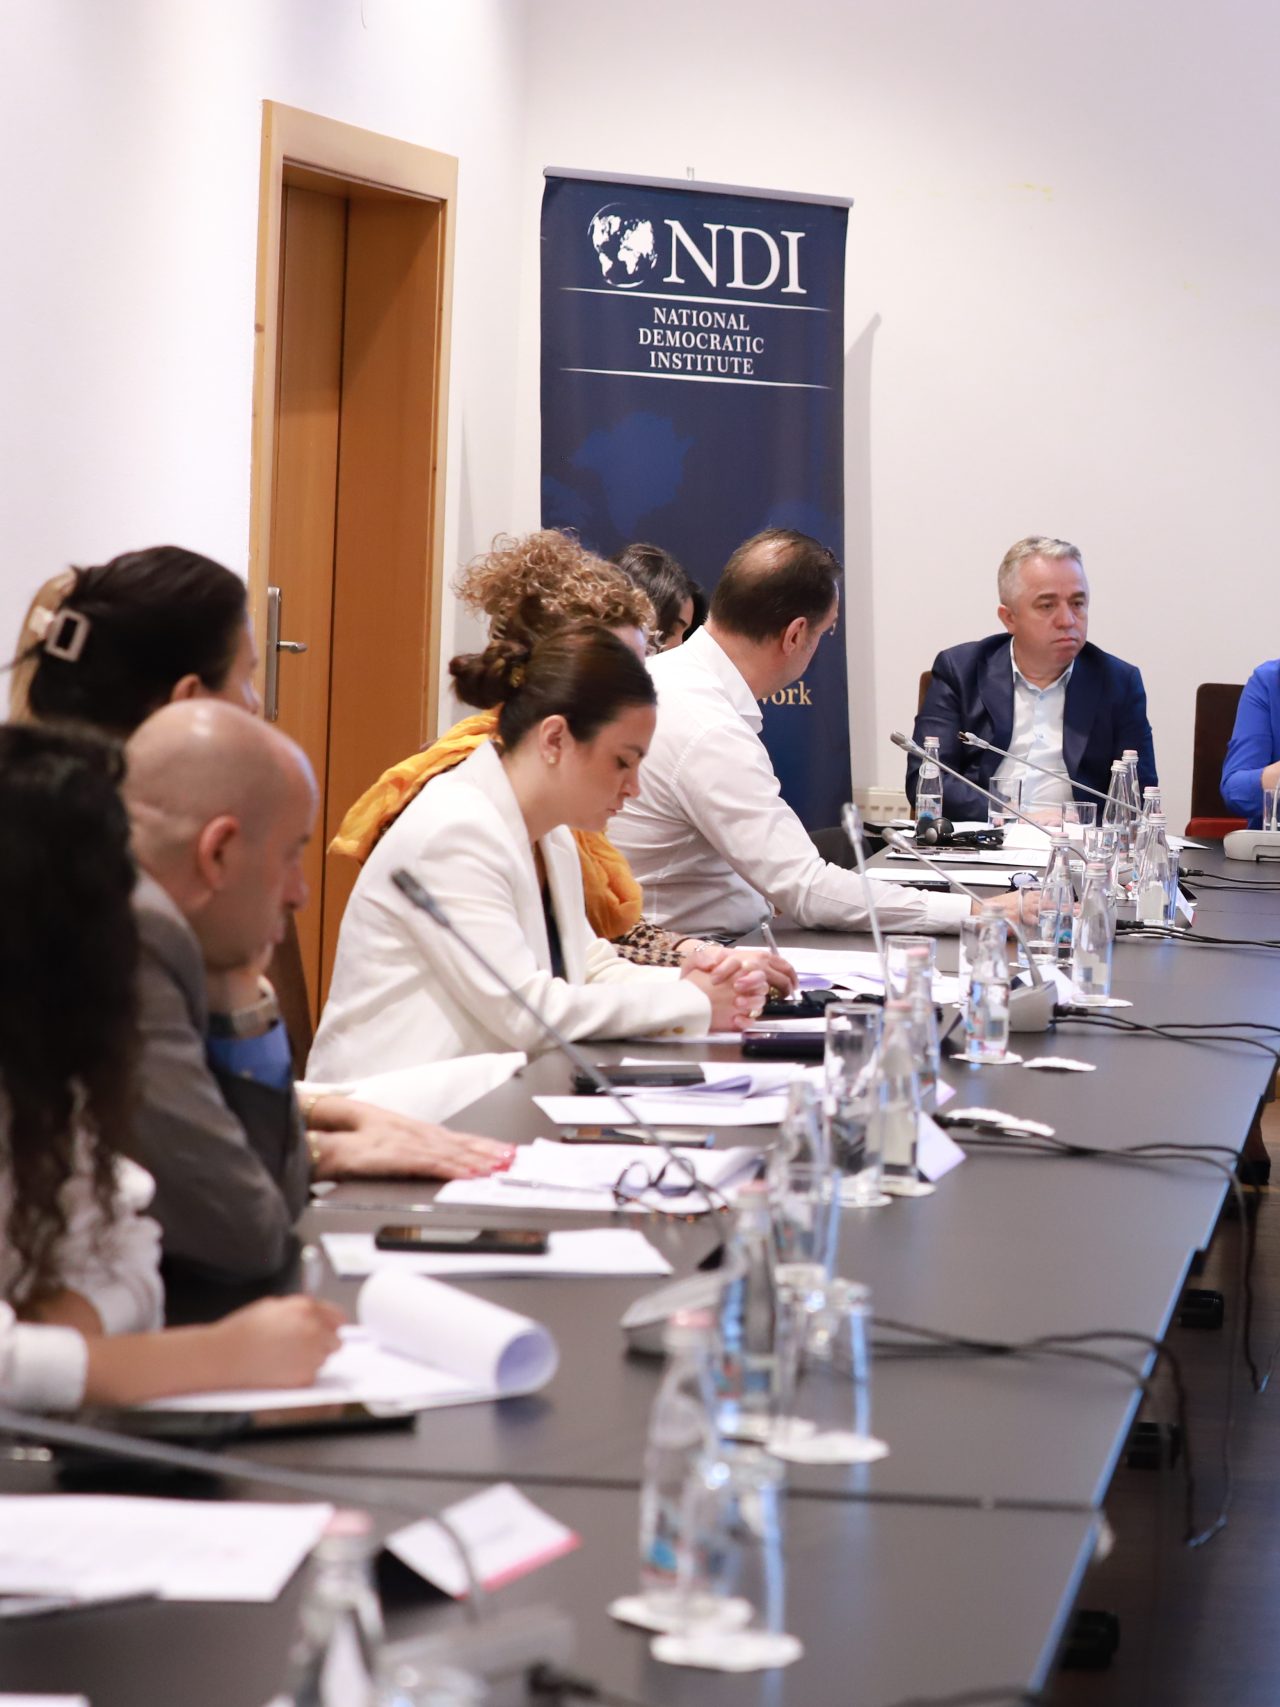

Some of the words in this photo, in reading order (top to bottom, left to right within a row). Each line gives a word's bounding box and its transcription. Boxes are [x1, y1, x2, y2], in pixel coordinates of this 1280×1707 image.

[663, 219, 807, 294] NDI
[653, 307, 750, 331] NATIONAL
[639, 328, 764, 354] DEMOCRATIC
[650, 352, 754, 375] INSTITUTE
[762, 681, 813, 706] ork
